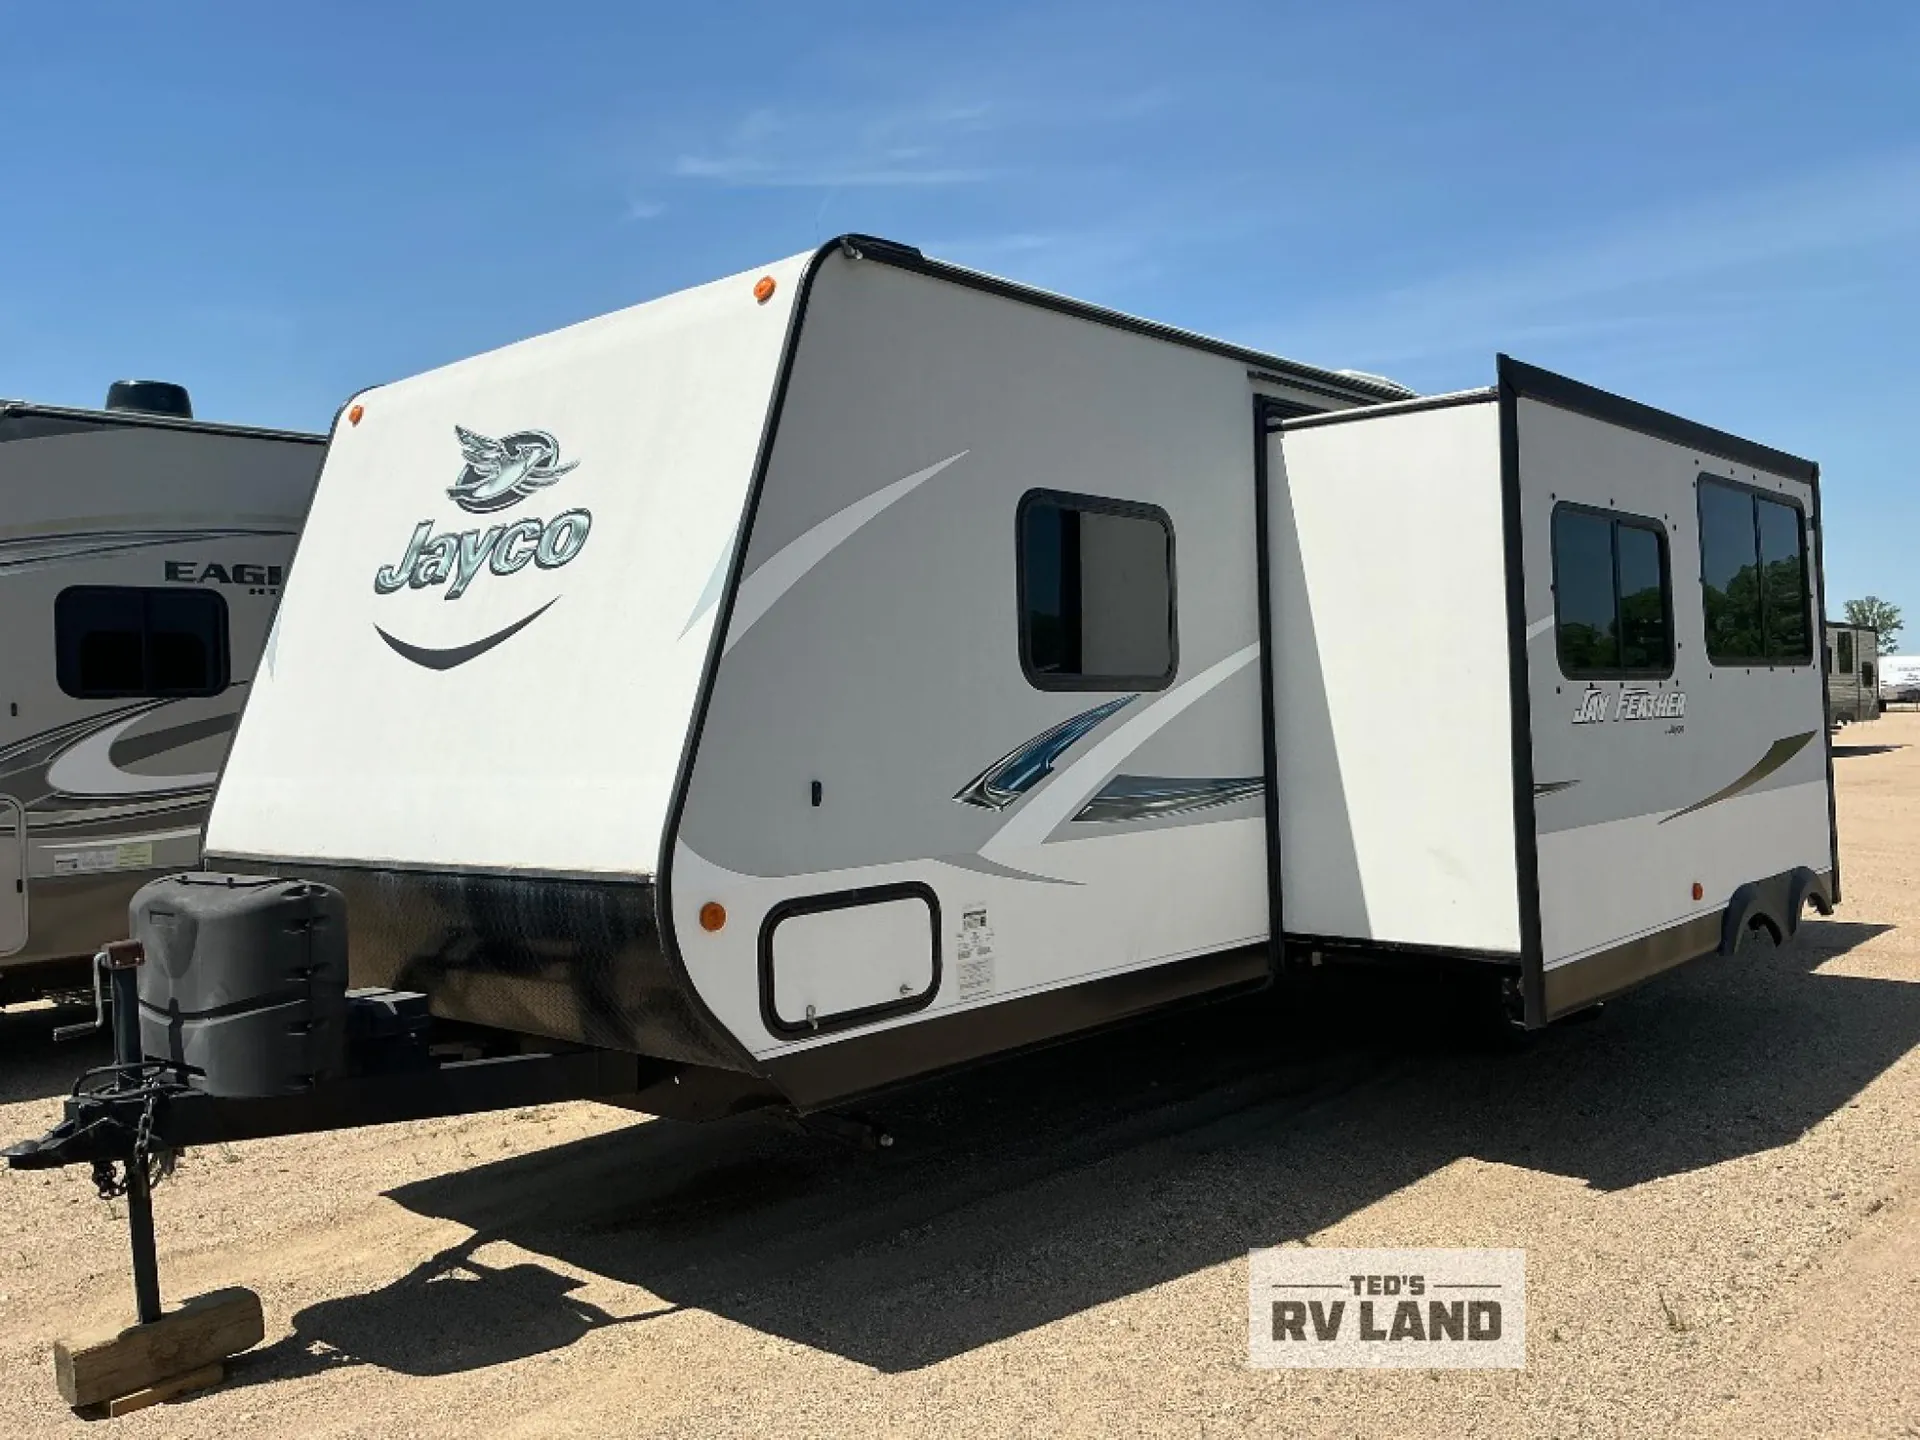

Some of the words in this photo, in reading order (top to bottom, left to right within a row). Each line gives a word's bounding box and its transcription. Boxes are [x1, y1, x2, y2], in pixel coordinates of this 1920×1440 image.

[374, 507, 592, 600] Jayco
[1572, 688, 1611, 724] JAY
[1613, 688, 1686, 721] FEATHER
